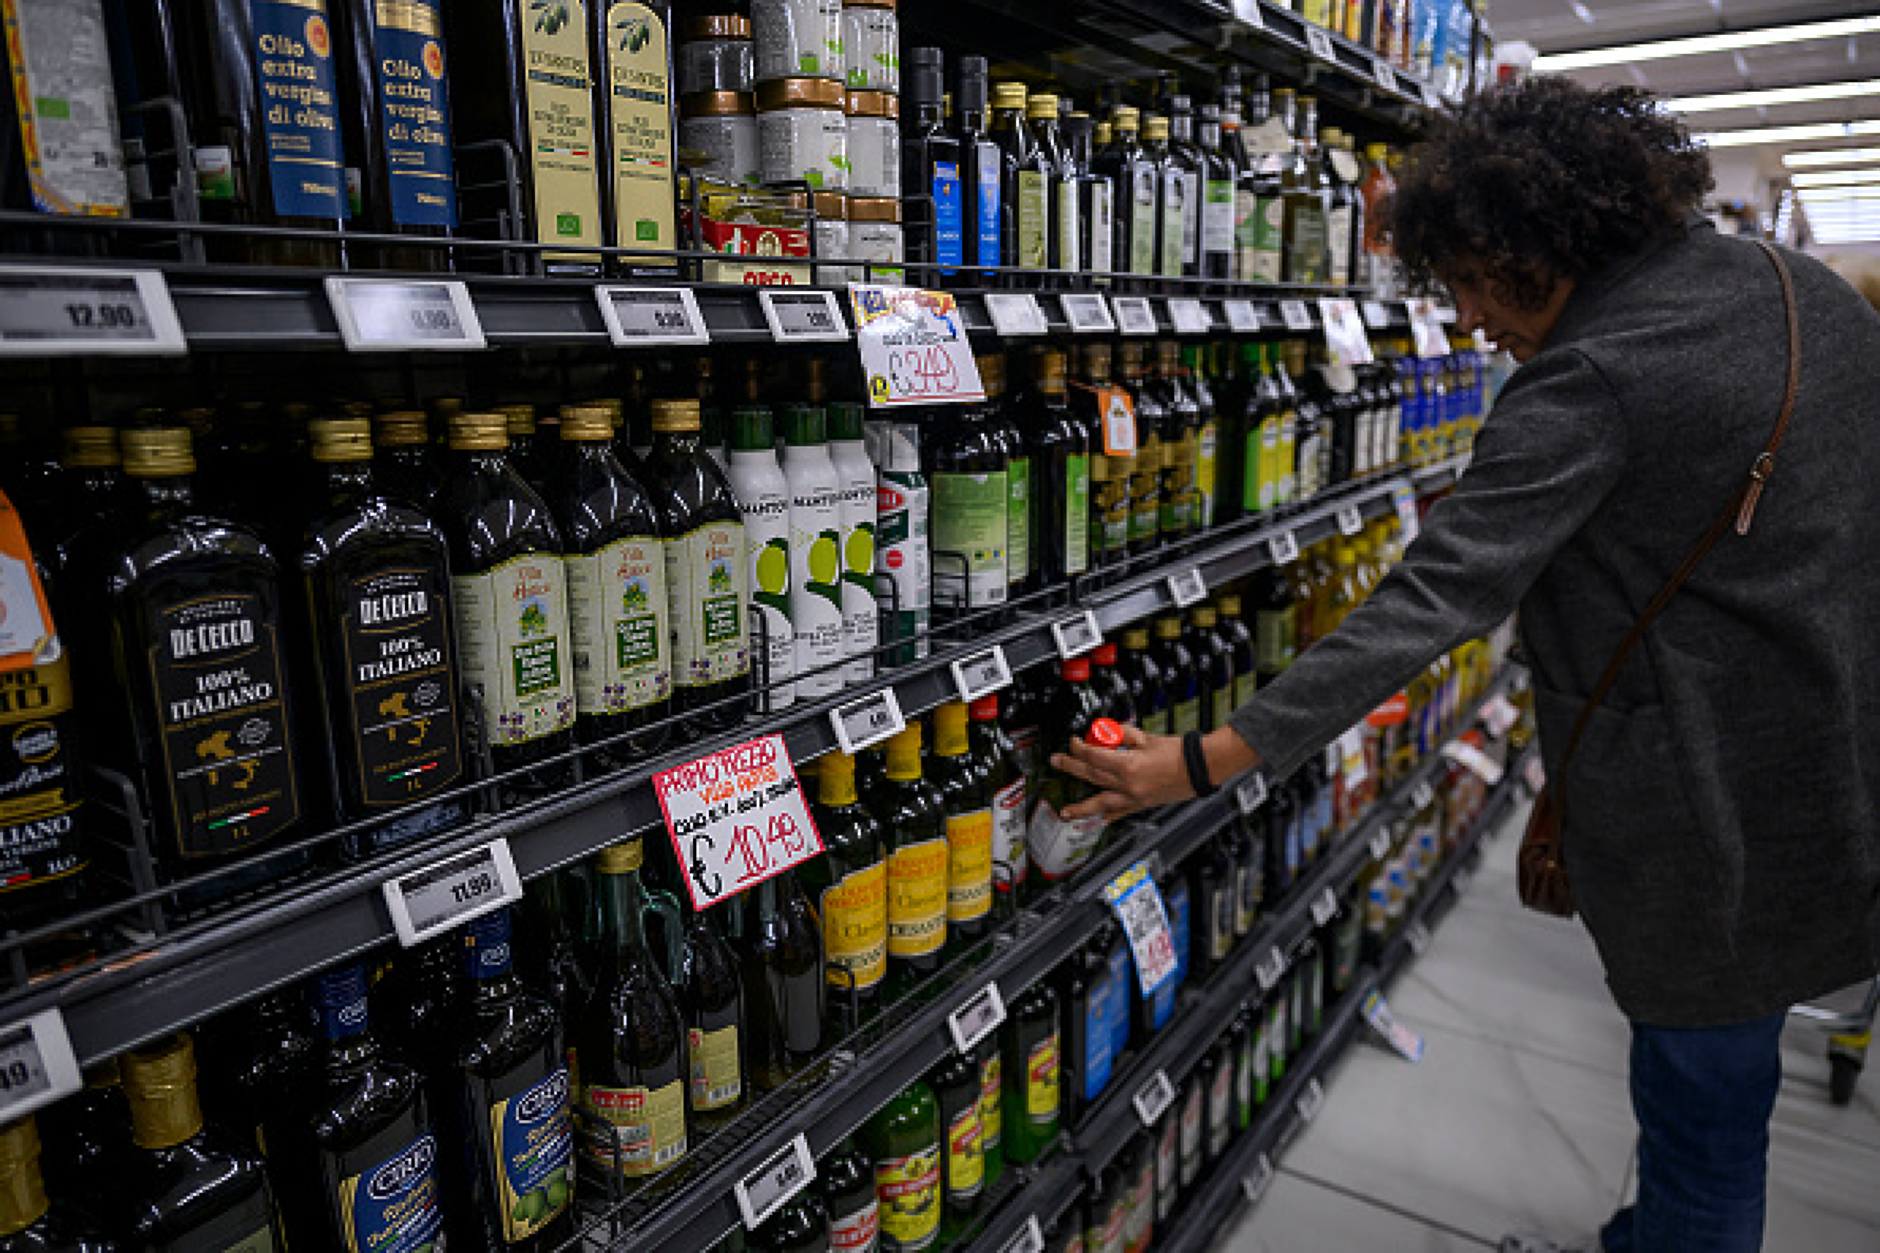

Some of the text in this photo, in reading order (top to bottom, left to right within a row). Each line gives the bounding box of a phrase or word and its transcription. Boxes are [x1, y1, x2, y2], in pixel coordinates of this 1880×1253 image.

[379, 634, 425, 657] 100%
[196, 666, 250, 694] 100%
[359, 648, 441, 682] ITALIANO
[170, 682, 273, 721] ITALIANO
[690, 834, 723, 898] €
